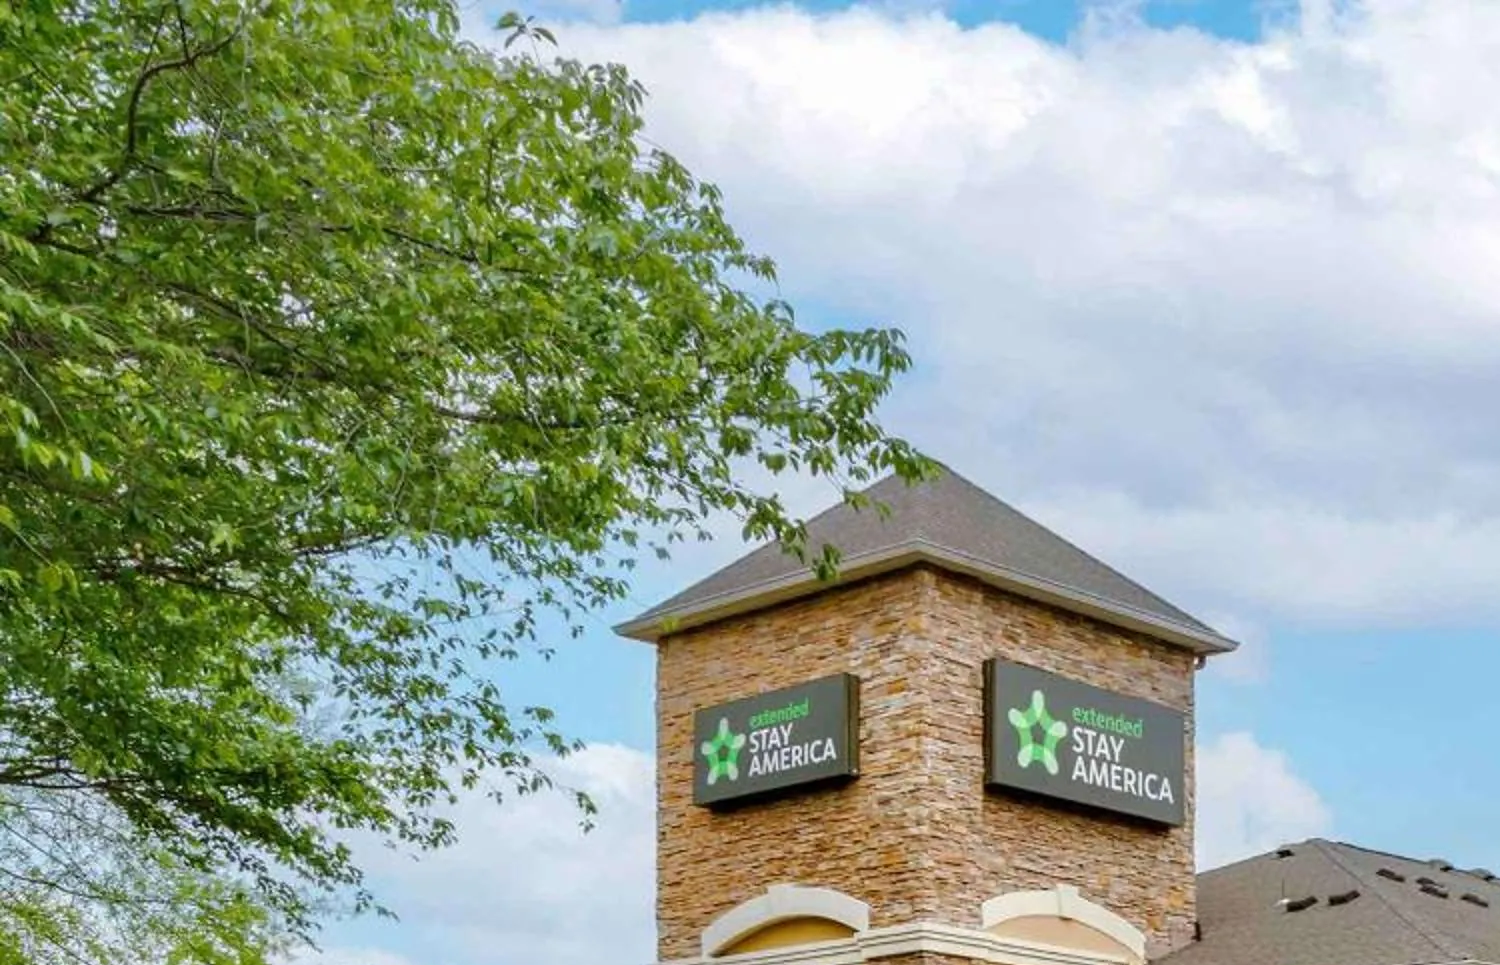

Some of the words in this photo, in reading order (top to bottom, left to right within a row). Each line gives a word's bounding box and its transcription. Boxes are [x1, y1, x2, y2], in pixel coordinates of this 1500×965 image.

[749, 697, 809, 730] extended
[1072, 707, 1143, 738] extended
[749, 722, 793, 753] STAY
[1072, 726, 1125, 763] STAY
[748, 738, 837, 777] AMERICA
[1072, 755, 1174, 804] AMERICA
